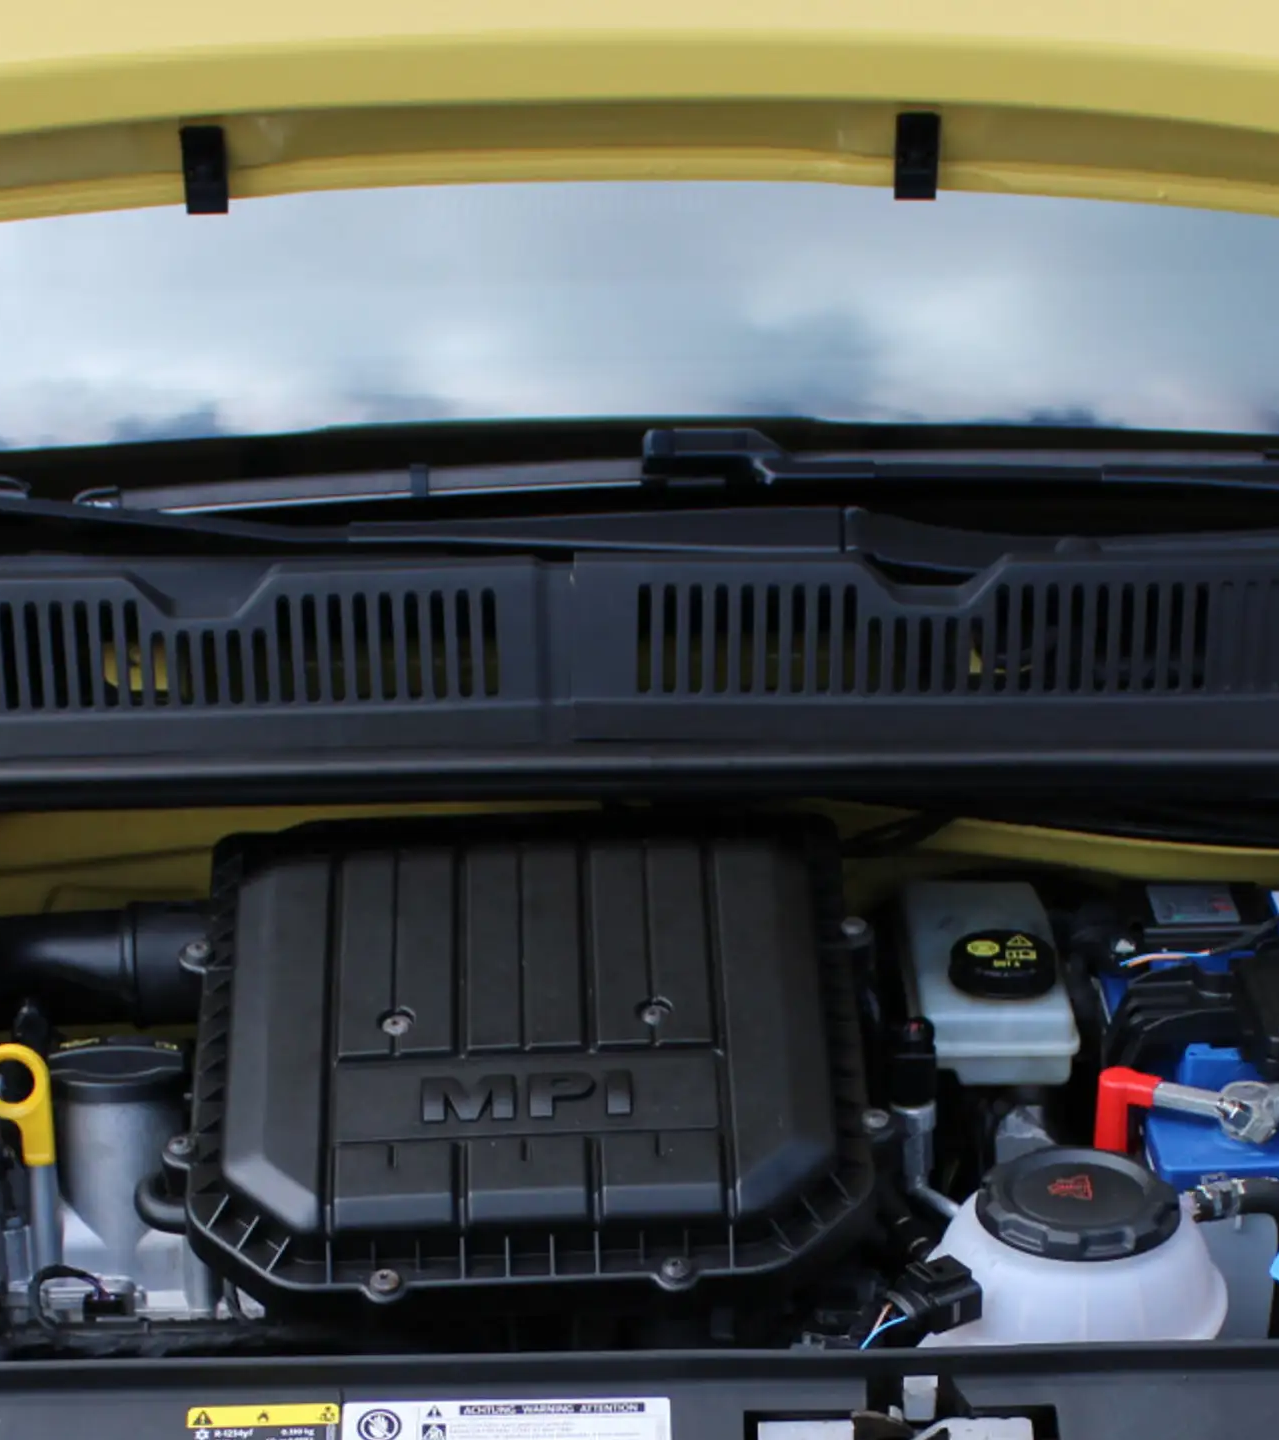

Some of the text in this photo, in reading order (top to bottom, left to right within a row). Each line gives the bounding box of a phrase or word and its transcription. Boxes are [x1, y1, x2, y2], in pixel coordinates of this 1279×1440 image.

[421, 1069, 633, 1124] MPI
[463, 1403, 638, 1415] ACHTUNG WARNING ATTENTION
